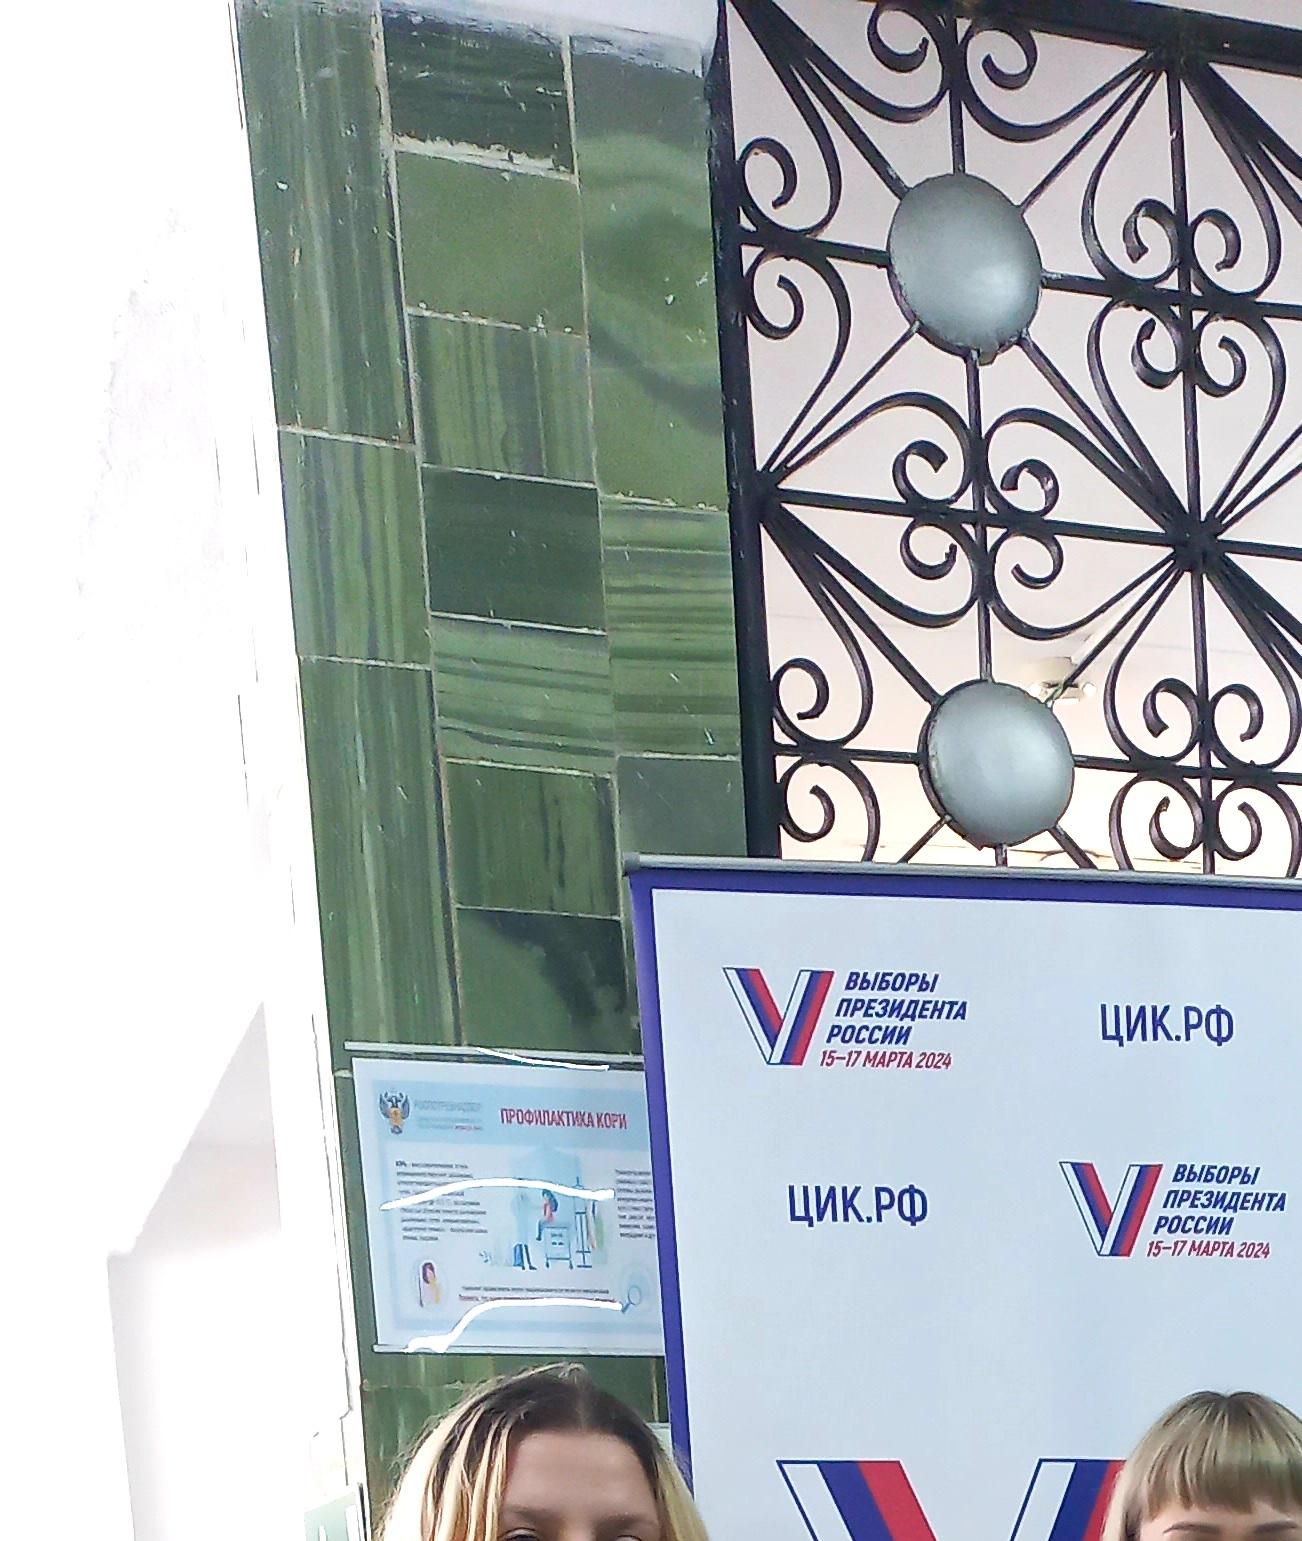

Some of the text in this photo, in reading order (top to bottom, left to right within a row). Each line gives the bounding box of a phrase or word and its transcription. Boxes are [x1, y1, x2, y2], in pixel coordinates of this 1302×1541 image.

[845, 971, 939, 993] ВЫБОРЫ
[835, 998, 967, 1022] ПРЕЗИДЕНТА
[826, 1024, 912, 1045] РОССИИ
[1100, 1003, 1234, 1047] ЦИК.РФ
[863, 1051, 912, 1068] МАРТА
[915, 1052, 951, 1069] 2024
[500, 1108, 594, 1128] ПРОФИЛАКТИКА
[596, 1112, 628, 1129] КОРИ
[1172, 1164, 1260, 1185] ВЫБОРЫ
[788, 1184, 928, 1227] ЦИК.РФ
[1162, 1189, 1287, 1213] ПРЕЗИДЕНТА
[1153, 1215, 1234, 1236] РОССИИ
[1187, 1241, 1234, 1258] МАРТА
[1237, 1242, 1270, 1259] 2024
